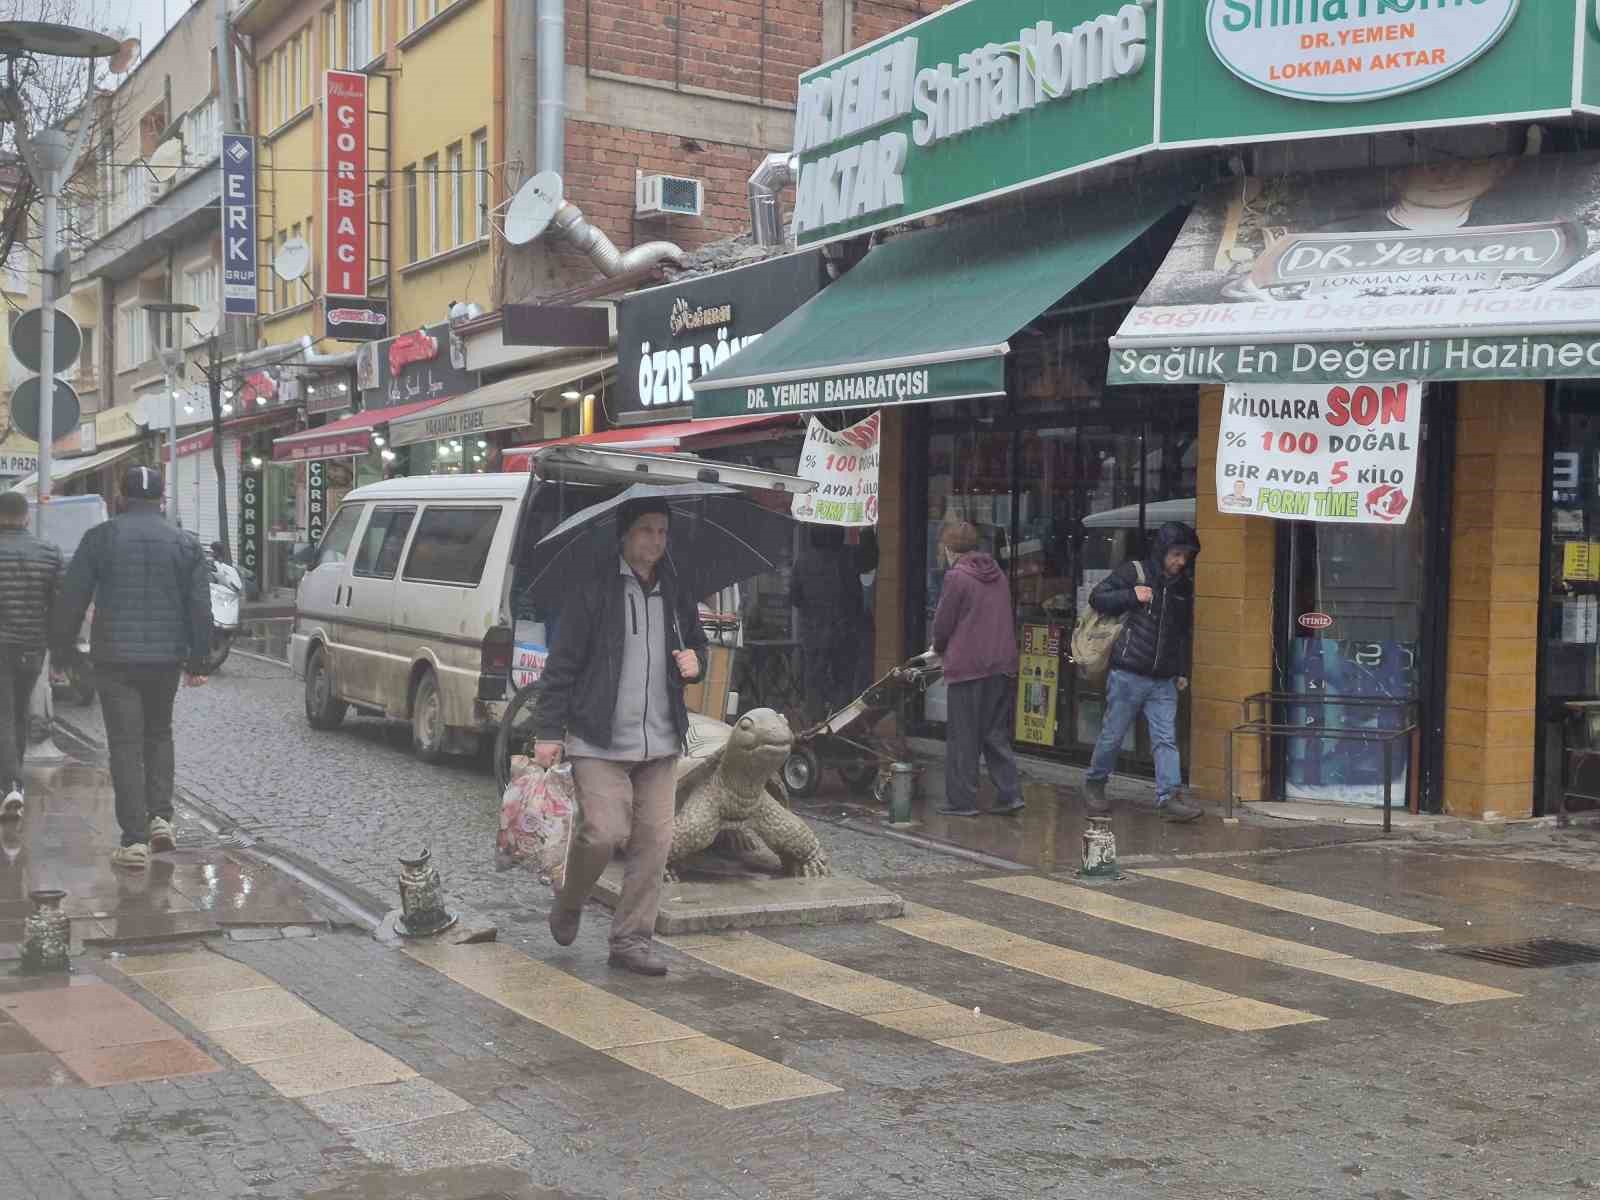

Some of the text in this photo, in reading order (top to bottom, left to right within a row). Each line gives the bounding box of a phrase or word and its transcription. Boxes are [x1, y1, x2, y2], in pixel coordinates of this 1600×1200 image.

[1299, 24, 1417, 50] DR.YEMEN
[1269, 48, 1447, 81] LOKMAN AKTAR
[336, 104, 356, 290] ÇORBACI
[790, 131, 908, 234] AKTAR
[227, 173, 249, 261] ERK
[1321, 271, 1488, 288] LOKMAN AKTAR
[1251, 304, 1295, 323] En
[638, 340, 695, 406] ÖZDE
[1119, 344, 1225, 381] Sağlık
[1237, 345, 1278, 373] En
[1292, 339, 1431, 379] Değerli
[747, 370, 929, 409] DR. YEMEN BAHARATÇISI
[1227, 382, 1408, 427] KİLOLARA SON
[1225, 429, 1411, 454] % 100 DOĞAL
[826, 453, 857, 472] 100
[1224, 460, 1405, 486] BİR AYDA 5 KİLO
[822, 484, 854, 497] AYDA
[1255, 486, 1359, 518] FORM TİME
